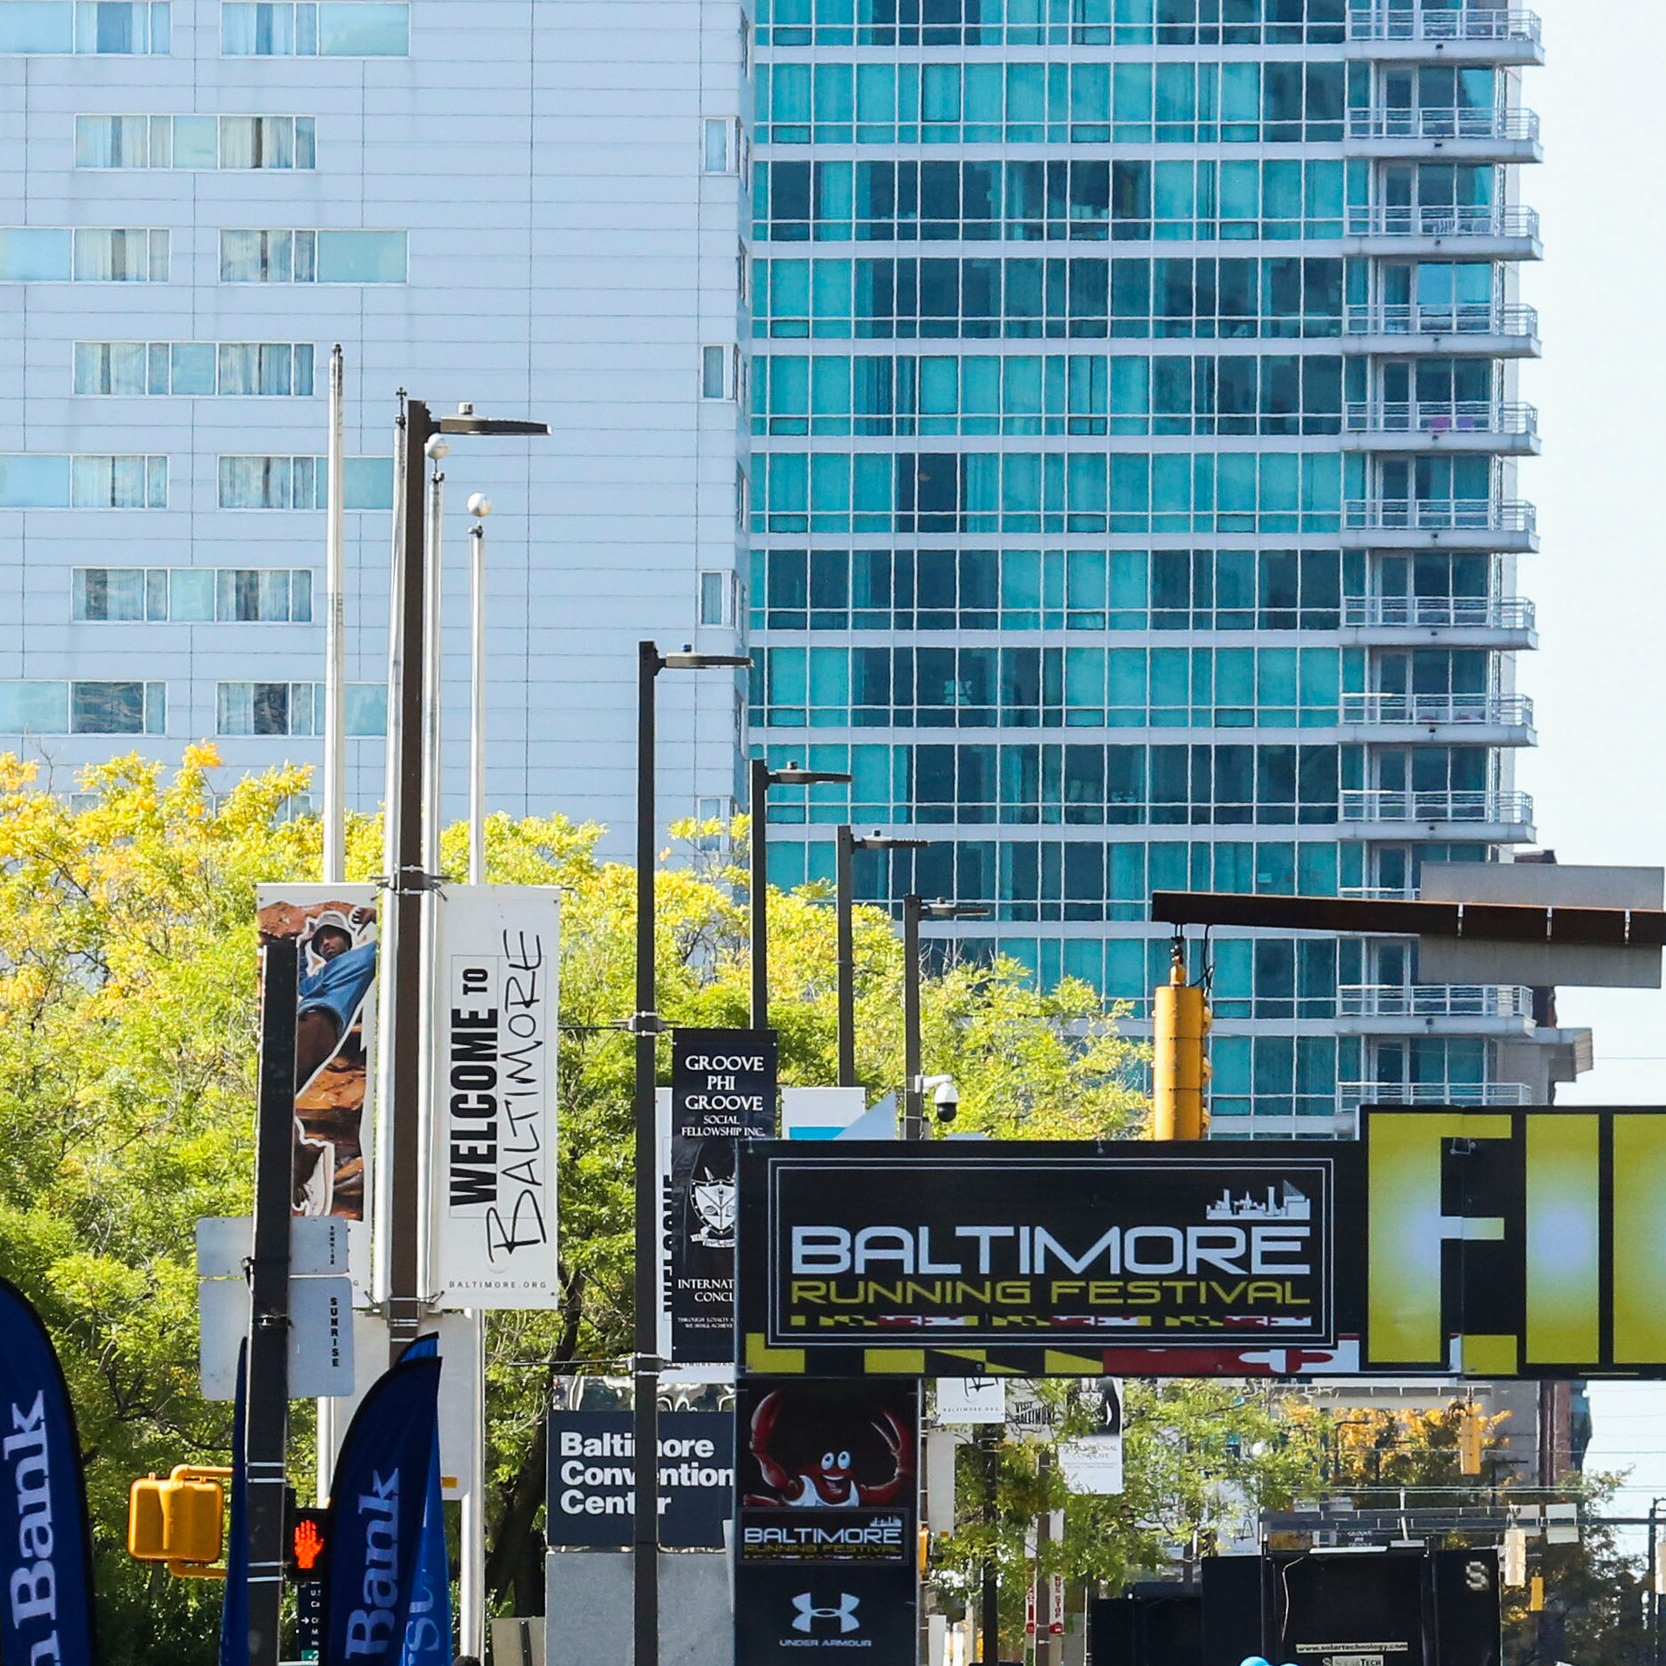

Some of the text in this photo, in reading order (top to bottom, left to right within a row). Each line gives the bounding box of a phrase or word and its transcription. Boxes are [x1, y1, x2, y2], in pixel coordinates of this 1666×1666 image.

[684, 1054, 765, 1072] GROOVE
[449, 966, 498, 1207] WELCOME TO
[706, 1075, 735, 1091] PHI
[485, 928, 548, 1264] BALTIMORE
[684, 1095, 764, 1111] GROOVE
[702, 1114, 740, 1125] SOCIAL
[680, 1126, 766, 1137] FELLOWSHIP INC.
[790, 1225, 1312, 1276] BALTIMORE
[448, 1279, 548, 1290] BALTIMORE.ORG
[790, 1280, 1312, 1305] RUNNING FESTIVAL
[329, 1296, 340, 1368] SUNRISE
[560, 1459, 735, 1487] Convntion
[2, 1388, 59, 1632] Bank
[560, 1488, 673, 1515] Centr
[743, 1527, 903, 1544] BALTIMORE
[744, 1544, 902, 1554] RUNNING FESTIVAL
[344, 1467, 400, 1660] Bank
[779, 1638, 873, 1648] UNDER ARMOUR
